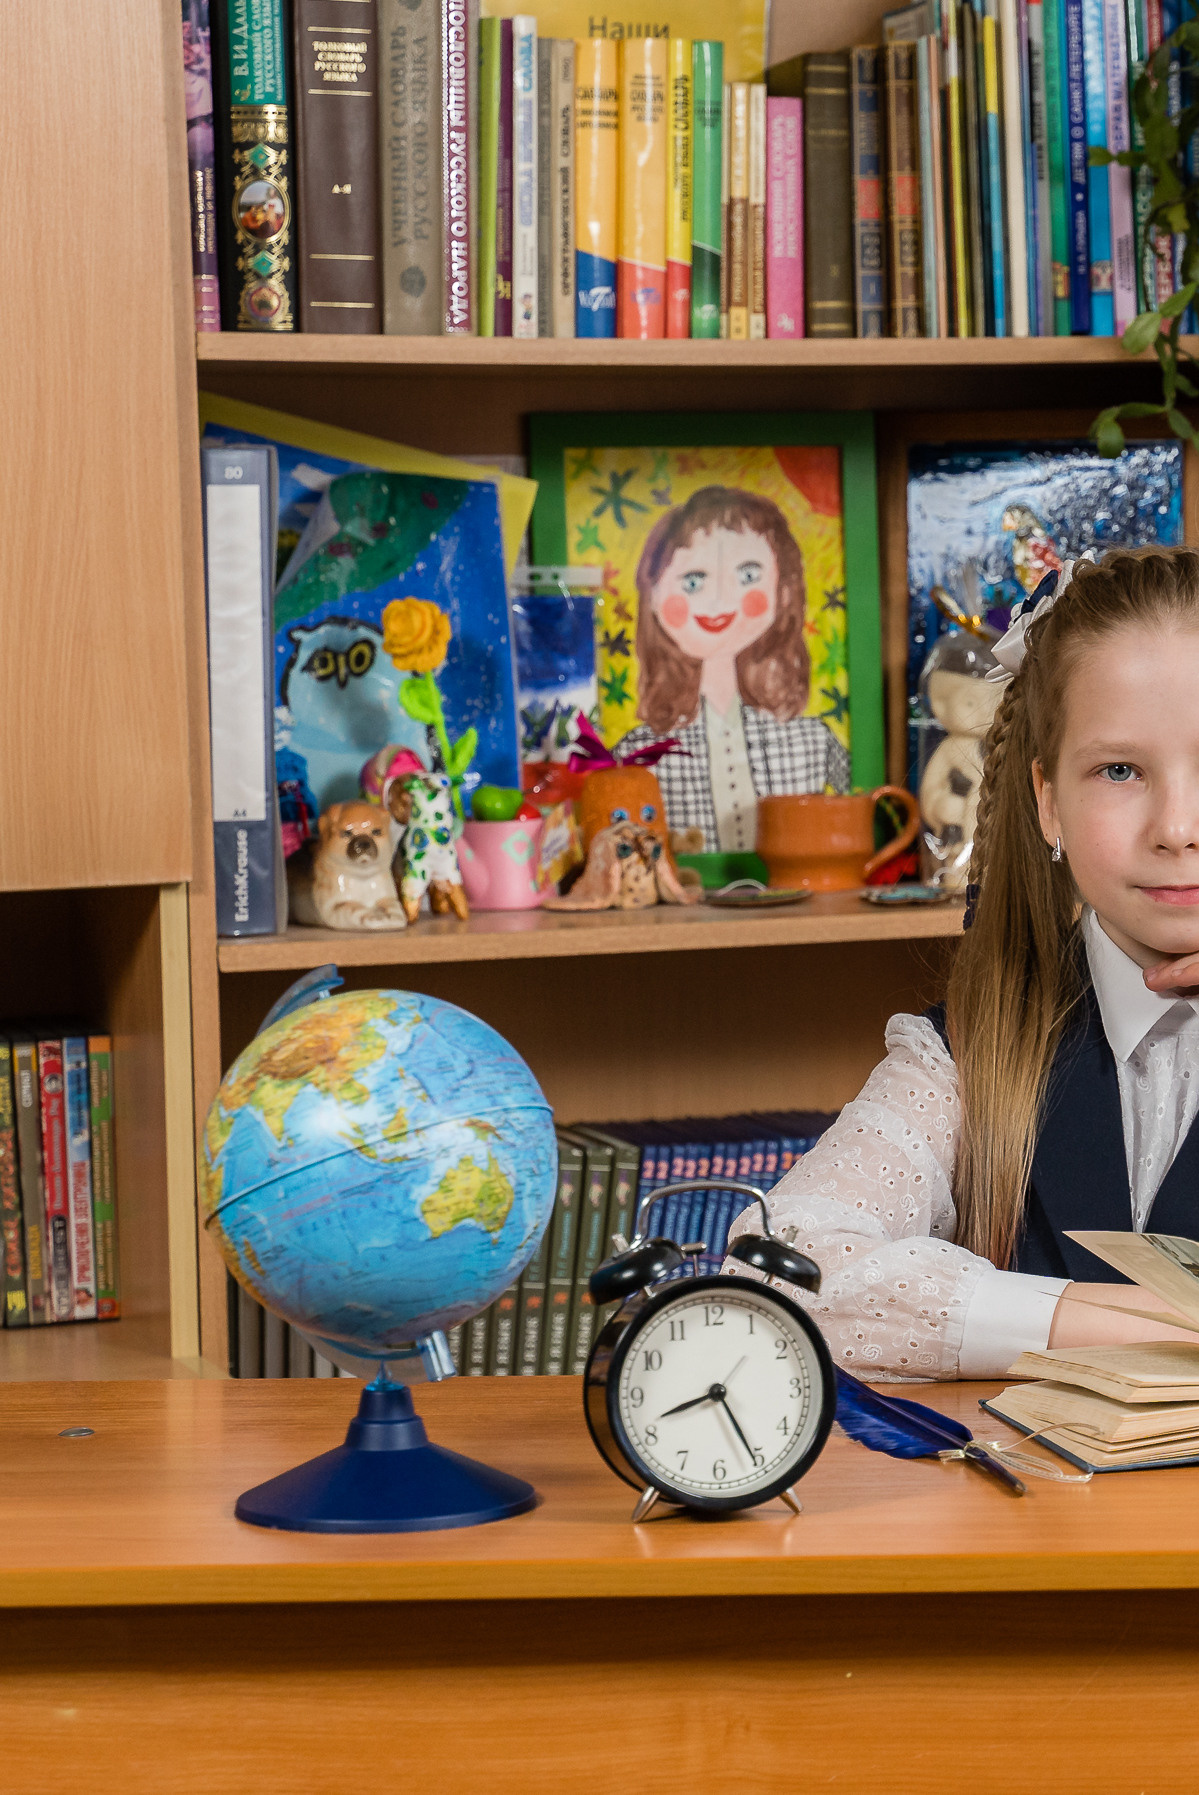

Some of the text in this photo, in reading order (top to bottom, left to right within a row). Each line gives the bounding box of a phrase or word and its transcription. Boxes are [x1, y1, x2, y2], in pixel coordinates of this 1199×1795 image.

[588, 15, 670, 41] Наши
[251, 32, 264, 101] ТОЛКОВЫЙ
[262, 28, 276, 93] РУССКОГО
[520, 33, 533, 92] СЛОВА
[388, 26, 410, 248] УЧЕБНЫЙ СЛОВАРЬ
[410, 36, 432, 240] РУССКОГО ЯЗЫКА
[450, 131, 468, 237] РУССКОГО
[450, 240, 469, 324] НАРОДА
[224, 466, 243, 480] 80
[234, 829, 249, 922] ErichKrause
[703, 1305, 725, 1327] 12
[747, 1313, 756, 1335] 1
[669, 1320, 686, 1342] 11
[642, 1349, 663, 1372] 10
[775, 1339, 788, 1360] 2
[630, 1386, 645, 1409] 9
[789, 1377, 802, 1400] 3
[644, 1425, 659, 1447] 8
[776, 1416, 790, 1437] 4
[676, 1450, 689, 1471] 7
[753, 1446, 765, 1468] 5
[712, 1459, 727, 1481] 6
